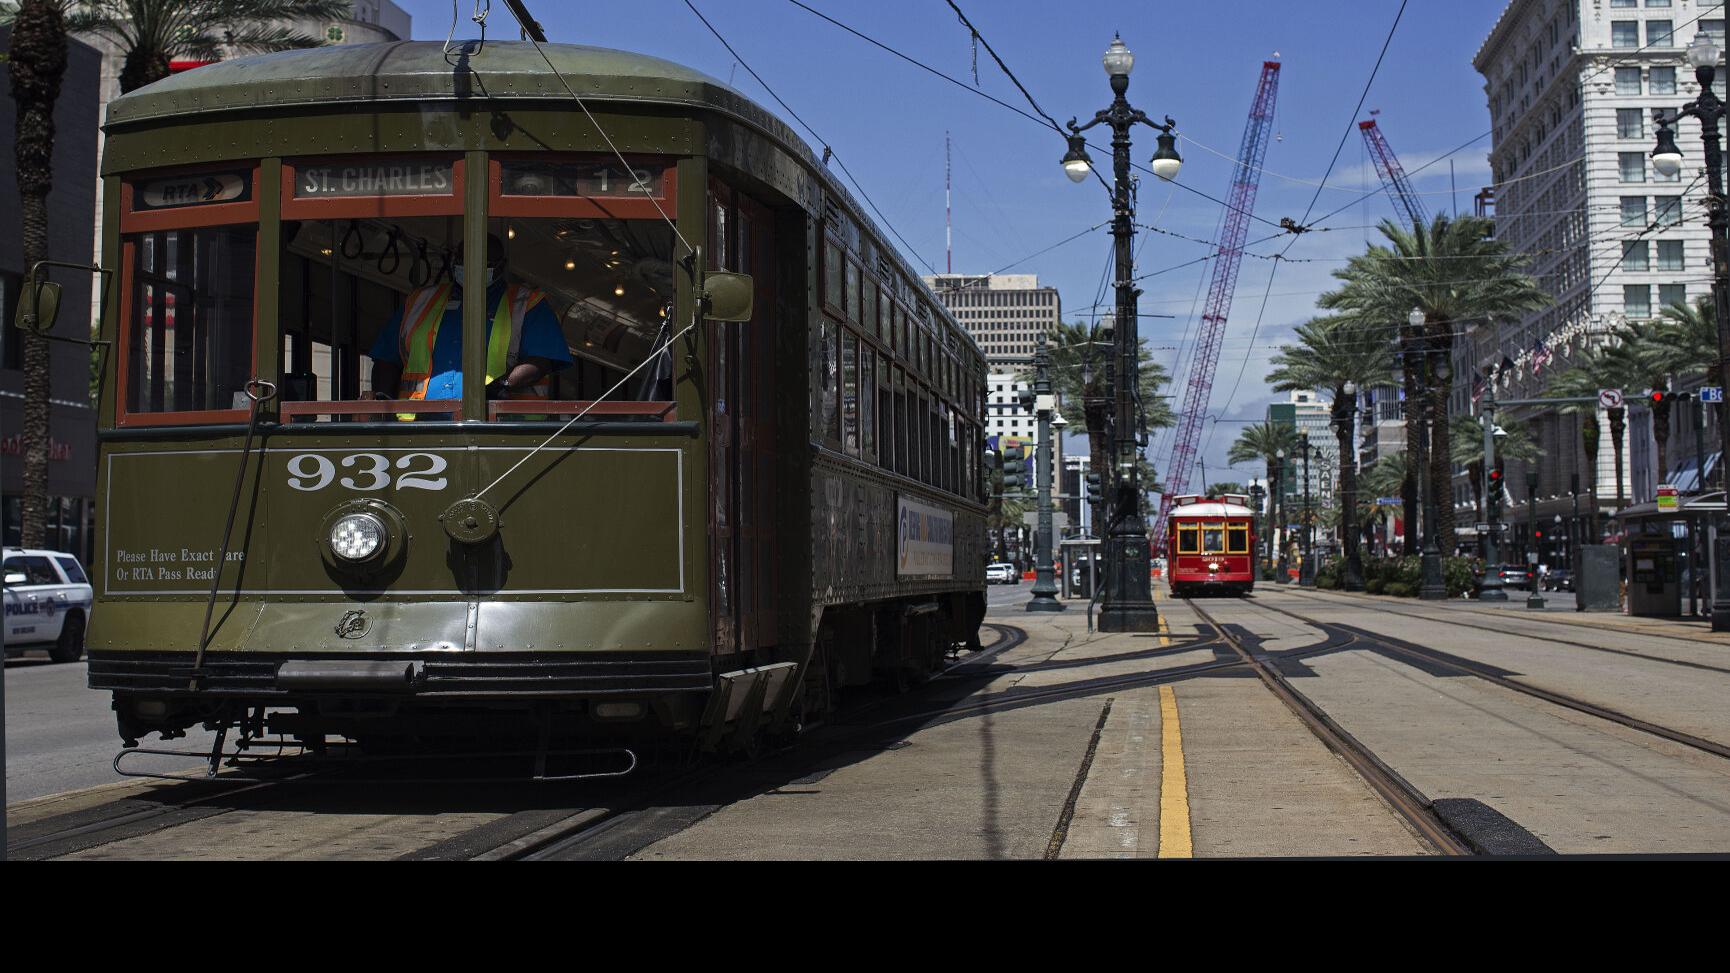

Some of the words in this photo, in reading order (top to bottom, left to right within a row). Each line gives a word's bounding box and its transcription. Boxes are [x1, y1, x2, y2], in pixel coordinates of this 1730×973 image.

[305, 168, 335, 193] ST.
[342, 166, 447, 192] CHARLES
[162, 182, 198, 202] RTA
[287, 453, 448, 491] 932
[116, 550, 146, 562] Please
[150, 549, 177, 562] Have
[181, 548, 214, 562] Exact
[219, 548, 245, 561] are
[116, 568, 129, 581] Or
[132, 568, 154, 581] RTA
[159, 567, 182, 580] Pass
[186, 566, 217, 580] Read
[6, 602, 39, 616] POLICE
